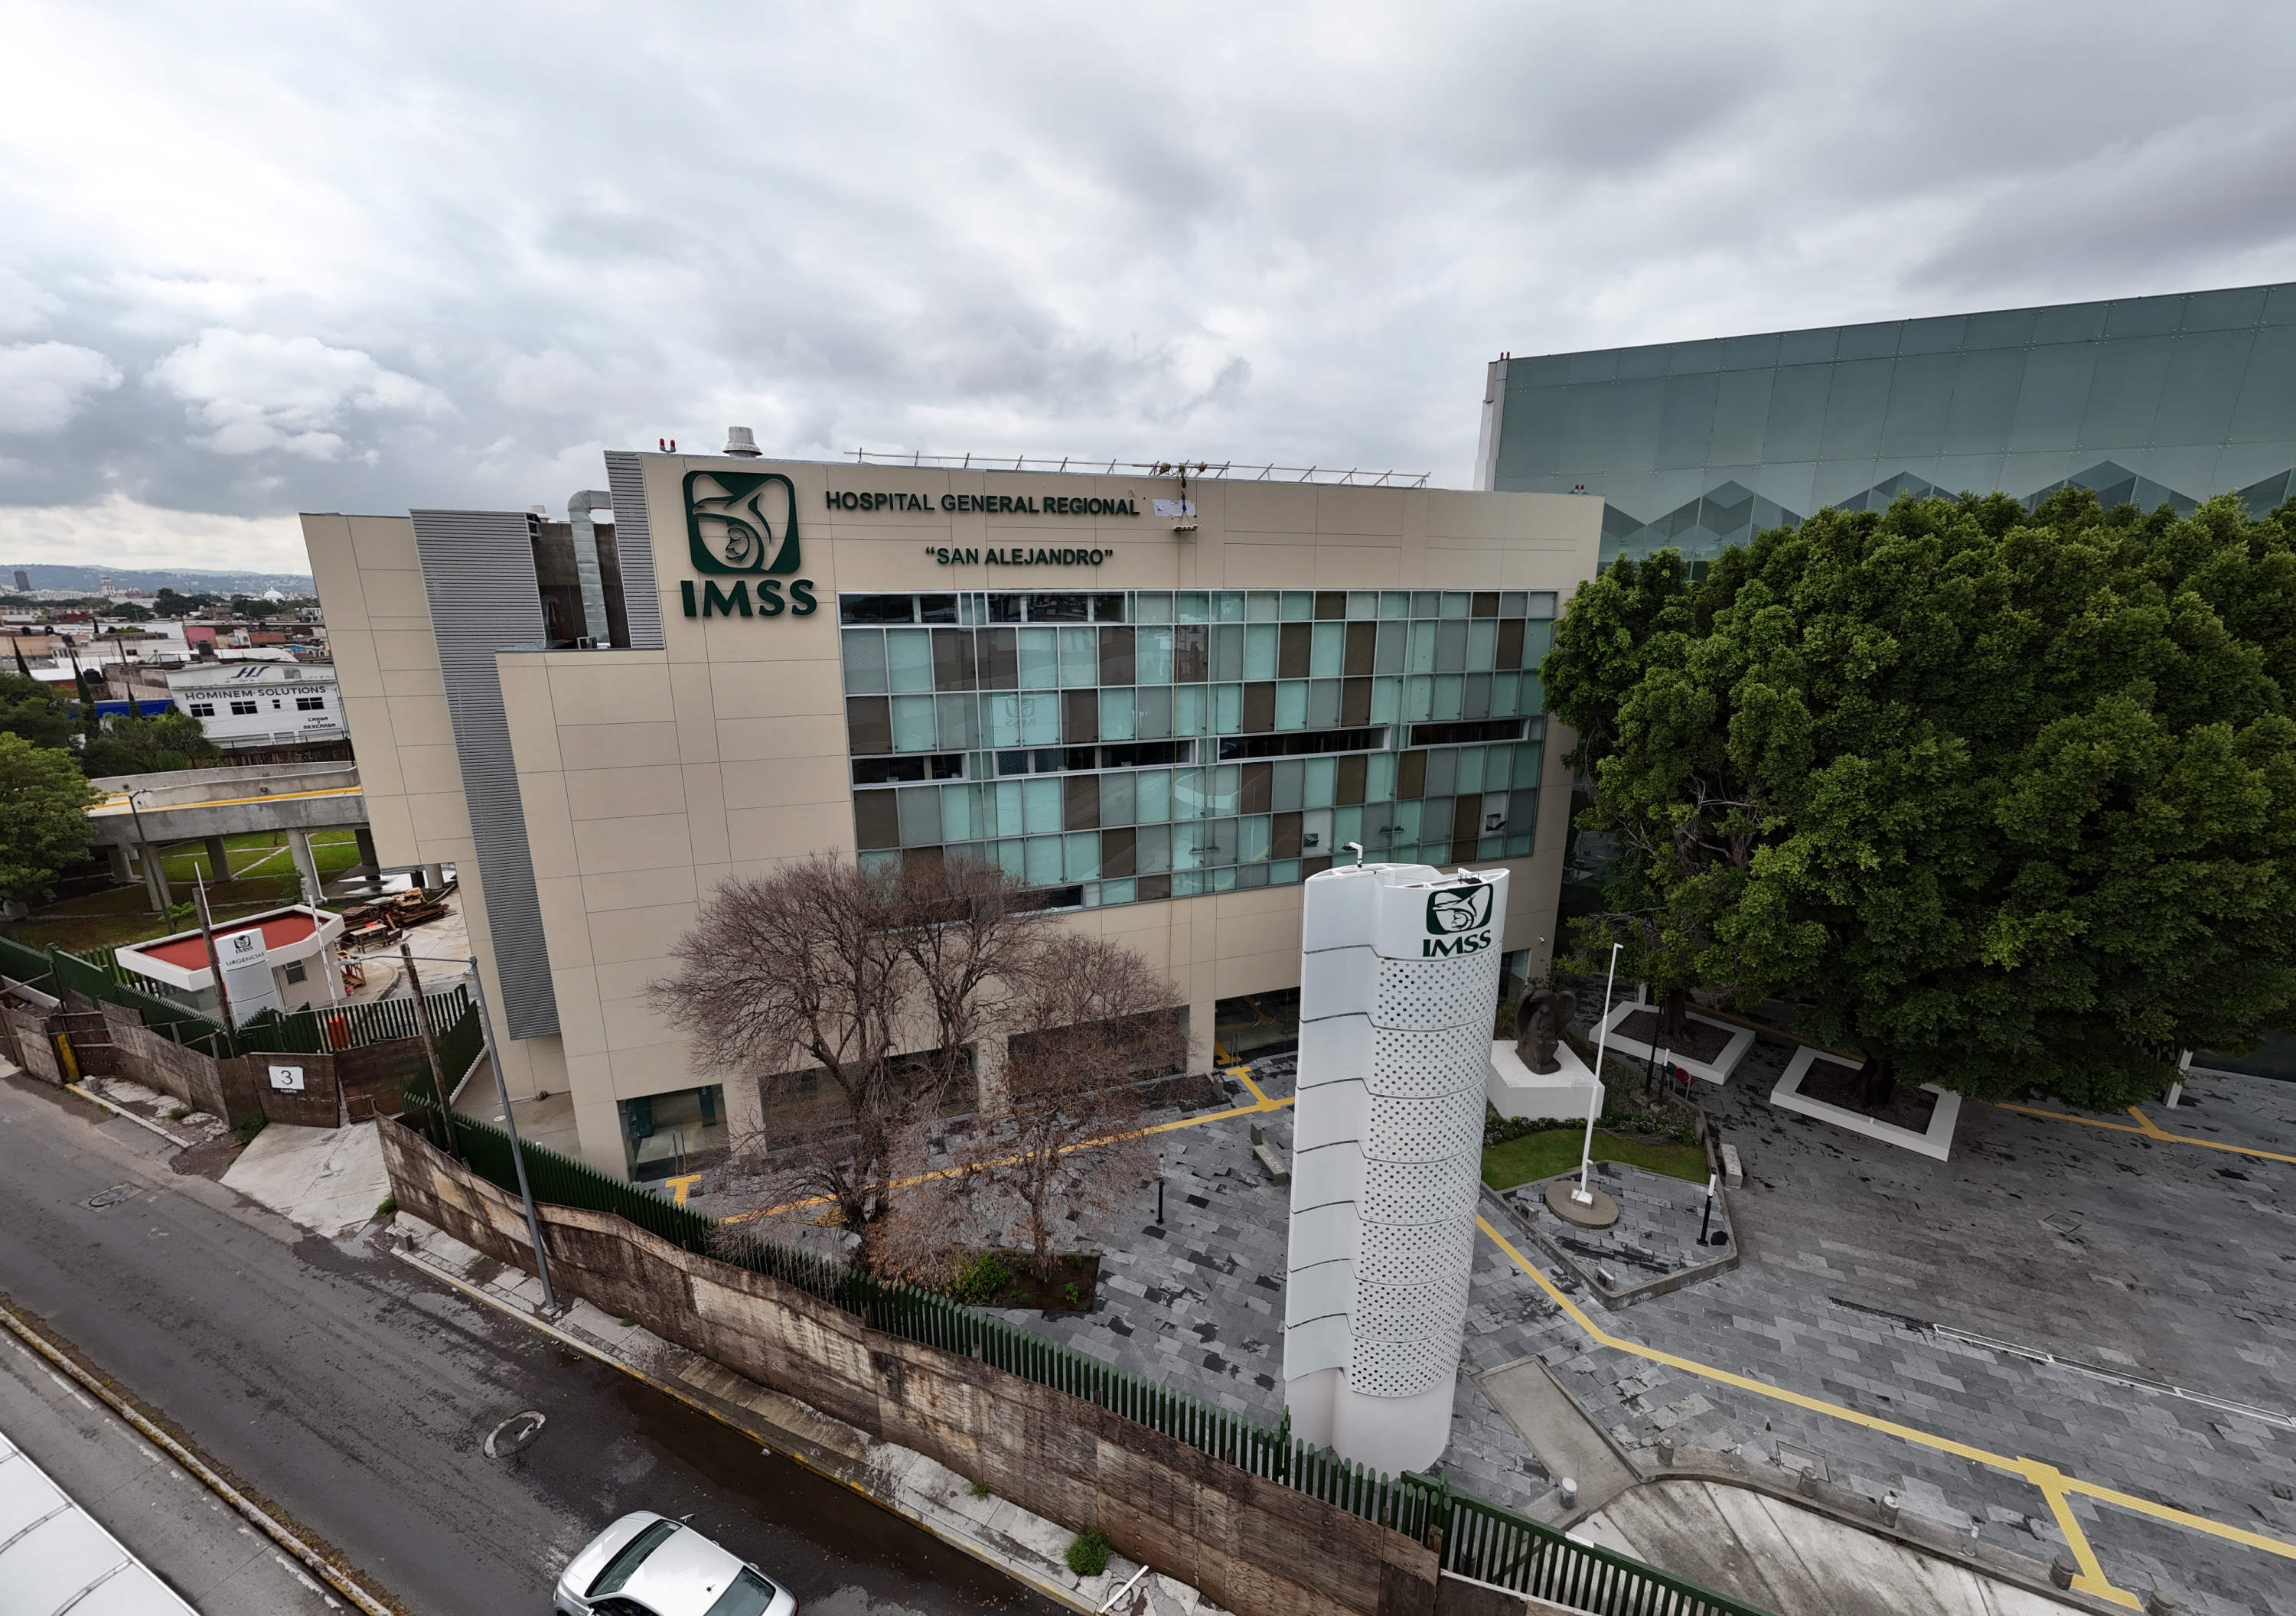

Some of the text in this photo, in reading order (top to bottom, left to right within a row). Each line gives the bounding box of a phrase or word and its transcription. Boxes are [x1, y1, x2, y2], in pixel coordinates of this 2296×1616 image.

[826, 490, 1140, 518] HOSPITAL GENERAL REGIONAL
[925, 546, 1114, 568] “SAN ALEJANDRO”
[680, 578, 817, 619] IMSS
[258, 686, 326, 697] SOLUTIONS
[235, 946, 253, 955] IMSS
[1422, 929, 1492, 957] IMSS
[226, 952, 265, 966] URGENCIAS
[281, 1070, 293, 1085] 3
